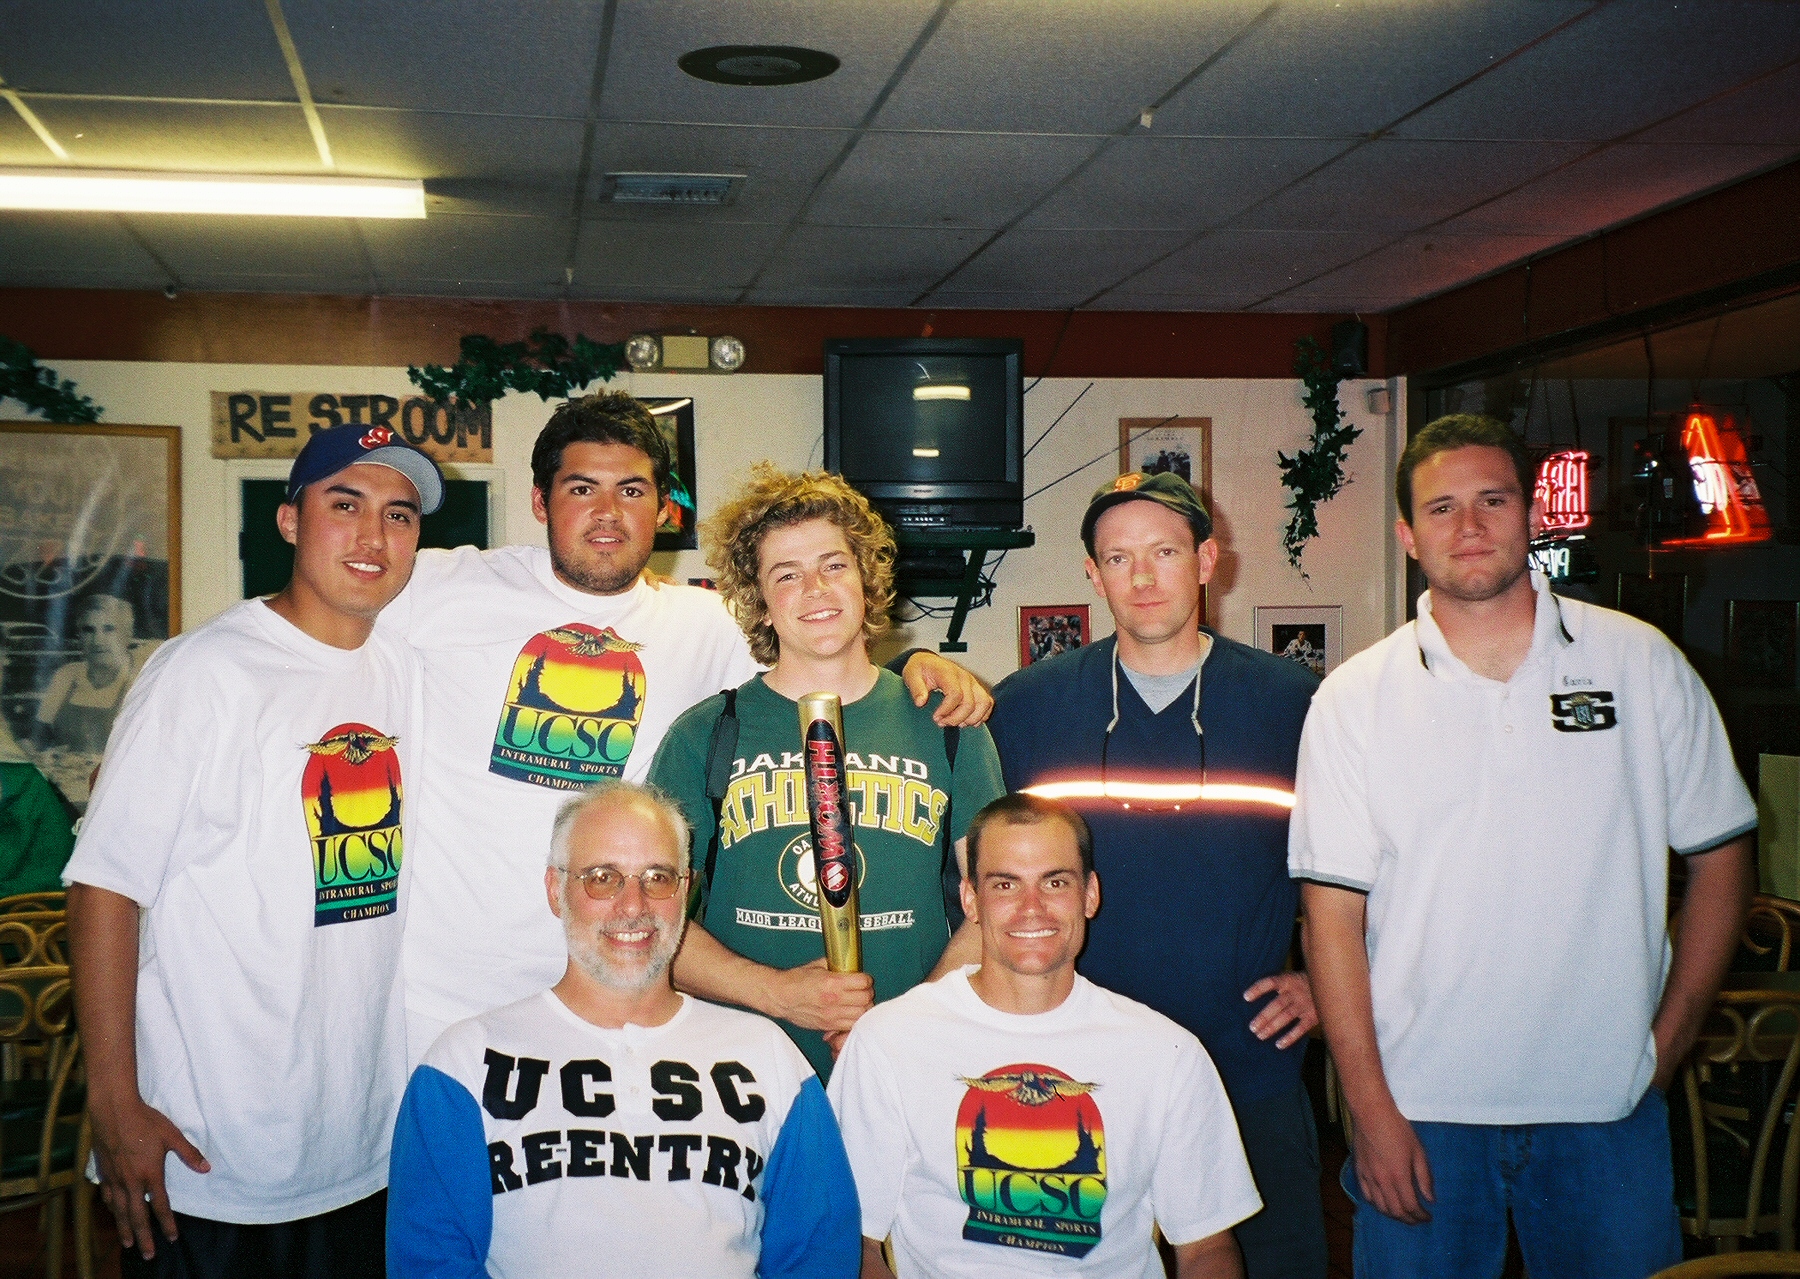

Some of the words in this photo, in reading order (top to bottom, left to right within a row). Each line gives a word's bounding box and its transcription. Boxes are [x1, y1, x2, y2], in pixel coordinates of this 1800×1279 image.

[227, 394, 297, 443] RE
[502, 705, 639, 762] UCSC
[500, 748, 571, 771] INTRAMURAL
[579, 763, 619, 776] SPORTS
[808, 741, 845, 860] WORTH
[312, 827, 403, 885] UCSC
[343, 902, 390, 920] CHAMPION
[736, 910, 772, 927] MAJOR
[962, 1169, 1108, 1220] UCSC
[976, 1209, 1046, 1230] INTRAMURAL
[1054, 1220, 1098, 1235] SPORTS
[998, 1234, 1066, 1253] CHAMPION
